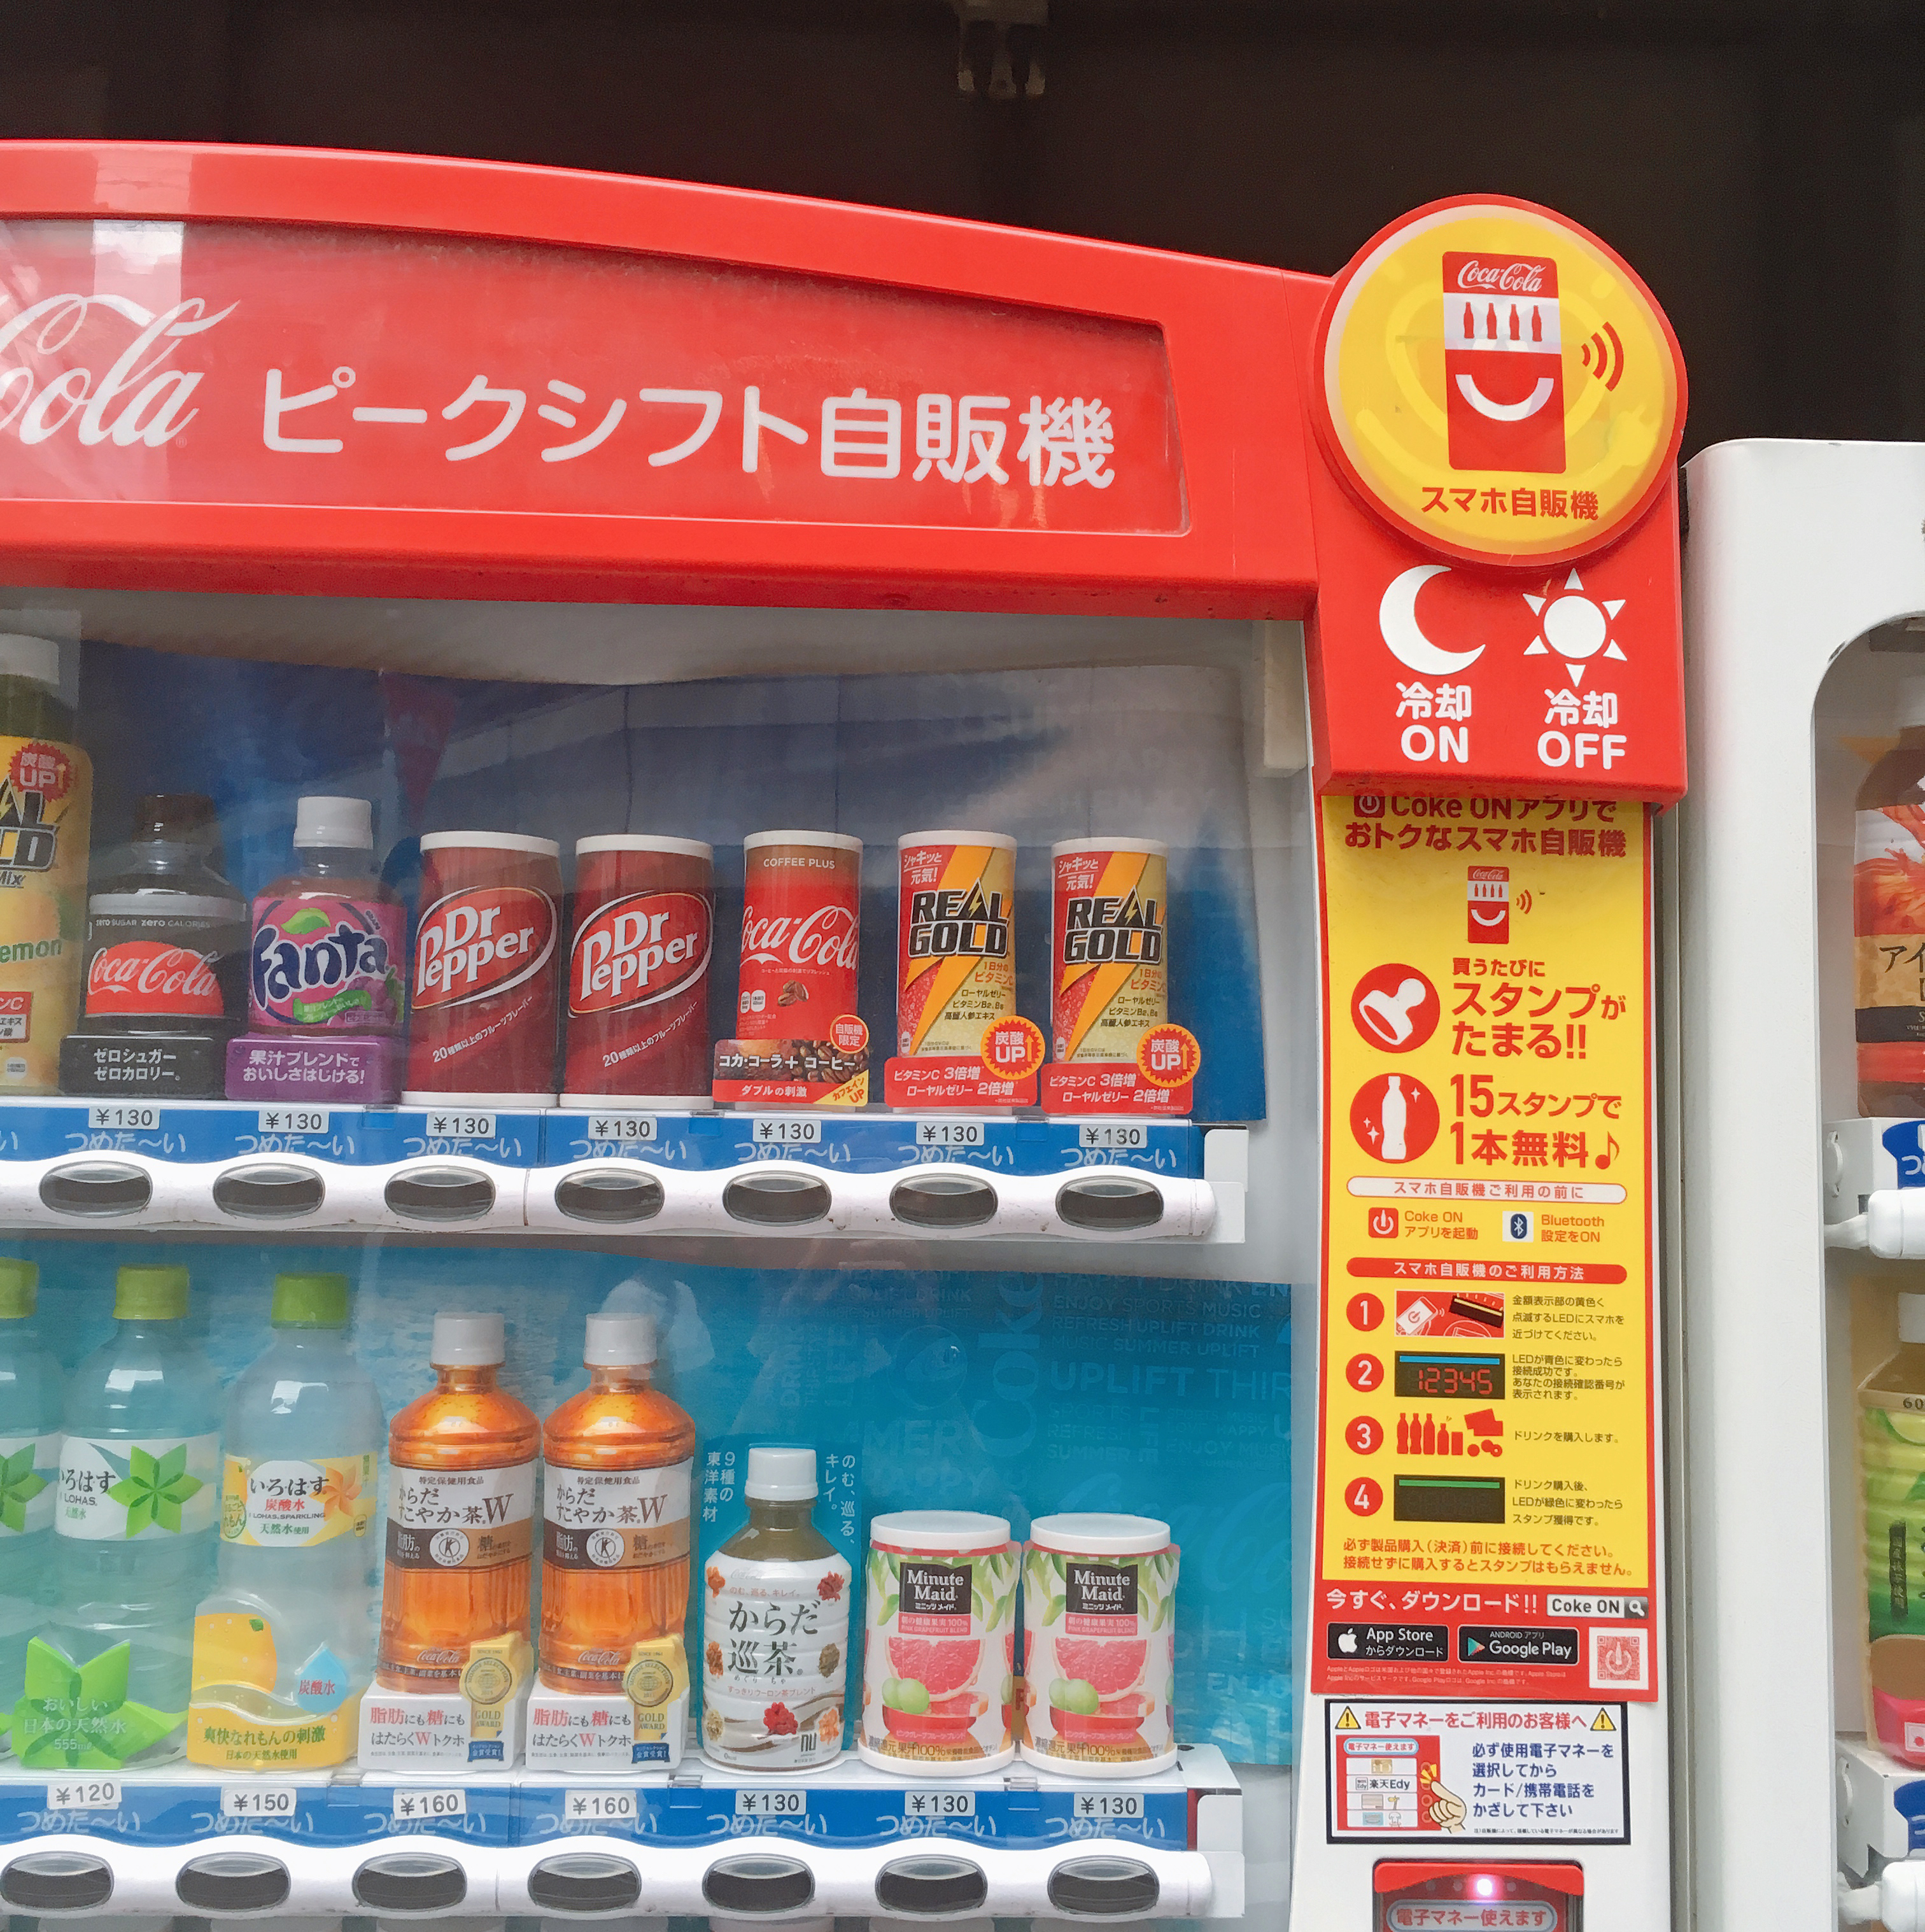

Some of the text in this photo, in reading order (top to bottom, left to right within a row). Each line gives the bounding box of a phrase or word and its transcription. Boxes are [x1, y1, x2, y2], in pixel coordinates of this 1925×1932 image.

[1458, 260, 1546, 292] Coca-Cola
[264, 366, 1115, 489] ピークシフト自販機
[1421, 487, 1598, 521] スマホ自販機
[1395, 682, 1472, 721] 冷却
[1544, 689, 1618, 728] 冷却
[1401, 724, 1469, 763] ON
[1537, 730, 1626, 770] OFF
[20, 768, 56, 787] UP
[1344, 822, 1626, 857] おトクなスマホ自販機
[764, 857, 835, 869] COFFEE PLUS
[911, 877, 1009, 924] REAL
[1066, 885, 1163, 932] REAL
[446, 905, 502, 945] Dr
[612, 912, 669, 957] Dr
[908, 921, 1007, 957] GOLD
[1064, 928, 1162, 964] GOLD
[253, 923, 388, 1010] Fanta
[416, 926, 535, 997] Pepper
[580, 929, 698, 1002] Pepper
[1452, 957, 1545, 977] 買うたびに
[88, 947, 224, 996] Coca-Cola
[1452, 982, 1626, 1020] スタンプが
[835, 1024, 863, 1035] 自販機
[996, 1031, 1024, 1045] 炭酸
[839, 1036, 860, 1047] 限定
[1151, 1039, 1179, 1053] 炭酸
[1452, 1021, 1586, 1059] たまる!!
[94, 1048, 177, 1064] ゼロシュガー
[249, 1050, 360, 1068] 果汁ブレンドで
[996, 1047, 1025, 1062] UP
[1152, 1054, 1180, 1070] UP
[94, 1067, 181, 1081] ゼロカロリー。
[244, 1068, 365, 1085] おいしさはじける!
[894, 1070, 940, 1081] ビタミンC
[1050, 1076, 1095, 1087] ビタミンC
[742, 1086, 807, 1097] ダブルの刺激
[833, 1077, 864, 1101] カフェイン
[849, 1089, 865, 1103] UP
[907, 1085, 973, 1096] ローヤルゼリー
[1063, 1092, 1129, 1103] ローヤルゼリー
[1450, 1074, 1621, 1118] 15スタンプで
[96, 1109, 153, 1125] ¥130
[265, 1113, 322, 1130] ¥130
[434, 1117, 489, 1134] ¥130
[596, 1121, 650, 1137] ¥130
[760, 1123, 814, 1139] ¥130
[923, 1125, 977, 1142] ¥130
[1086, 1127, 1141, 1145] ¥130
[1393, 1181, 1583, 1199] スマホ自販機ご利用の前に
[1404, 1211, 1463, 1223] Coke ON
[1541, 1215, 1604, 1227] Bluetooth
[1404, 1227, 1478, 1241] アプリを起動
[1541, 1230, 1600, 1244] 設定をON
[1393, 1262, 1584, 1280] スマホ自販機のご利用方法
[1202, 1301, 1261, 1318] MUSIC
[1512, 1295, 1604, 1308] 金額表示部の黄色く
[1360, 1301, 1369, 1325] 1
[1512, 1312, 1624, 1325] 点滅するLEDにスマホを
[1512, 1329, 1597, 1341] 近づけてください。
[1512, 1354, 1623, 1367] LEDが青色に変わったら
[1050, 1360, 1195, 1399] UPLIFT
[1358, 1360, 1372, 1386] 2
[1512, 1365, 1577, 1377] 接続成功です。
[1419, 1367, 1493, 1395] 12345
[1512, 1378, 1625, 1391] あなたの接続確認番号が
[1512, 1388, 1577, 1400] 表示されます。
[1357, 1423, 1371, 1448] 3
[1514, 1430, 1618, 1443] ドリンクを購入します。
[419, 1476, 484, 1485] 特定保健用食品
[577, 1476, 640, 1485] 特定保健用食品
[720, 1451, 735, 1502] 9種の
[823, 1454, 840, 1510] キレイ。
[1514, 1479, 1588, 1491] ドリンク購入後、
[557, 1484, 596, 1505] からだ
[702, 1451, 721, 1523] 東洋素材
[265, 1499, 305, 1511] 炭酸水
[1354, 1484, 1369, 1509] 4
[1512, 1497, 1623, 1509] LEDが緑色に変わったら
[1343, 1556, 1633, 1577] 接続せずに購入するとスタンプはもらえません。
[907, 1570, 964, 1586] Minute
[1074, 1570, 1130, 1586] Minute
[914, 1585, 957, 1601] Maid
[1082, 1586, 1124, 1601] Maid
[1551, 1598, 1619, 1614] Coke ON
[729, 1600, 821, 1636] からだ
[1366, 1628, 1434, 1643] App Store
[1490, 1631, 1523, 1639] ANDROID
[1365, 1645, 1443, 1658] からダウンロード
[1489, 1640, 1572, 1660] Google Play
[299, 1681, 335, 1695] 炭酸水
[43, 1697, 108, 1712] おいしい
[370, 1707, 465, 1726] 脂肪にも糖にも
[475, 1710, 500, 1719] GOLD
[533, 1708, 631, 1727] 脂肪にも糖にも
[638, 1713, 665, 1722] GOLD
[1365, 1710, 1587, 1730] 電子マネーをご利用のお客様へ
[24, 1719, 127, 1735] 日本の天然水
[204, 1727, 325, 1745] 爽快なれもんの刺激
[372, 1731, 465, 1746] はたらくWトクホ
[533, 1733, 631, 1747] はたらくWトクホ
[225, 1749, 297, 1760] 日本の天然水使用
[1348, 1743, 1414, 1751] 電子マネー使えます
[1472, 1742, 1614, 1758] 必ず使用電子マネーを
[1472, 1763, 1556, 1778] 選択してから
[1370, 1779, 1410, 1790] 楽天Edy
[1472, 1782, 1594, 1799] カード/携帯電話を
[56, 1785, 115, 1805] ¥120
[234, 1794, 288, 1811] ¥150
[742, 1794, 799, 1812] ¥130
[400, 1795, 459, 1816] ¥160
[572, 1797, 630, 1814] ¥160
[912, 1795, 968, 1813] ¥130
[1081, 1796, 1138, 1814] ¥130
[1472, 1802, 1572, 1819] かざして下さい
[1396, 1909, 1548, 1927] 電子マネー使えます
